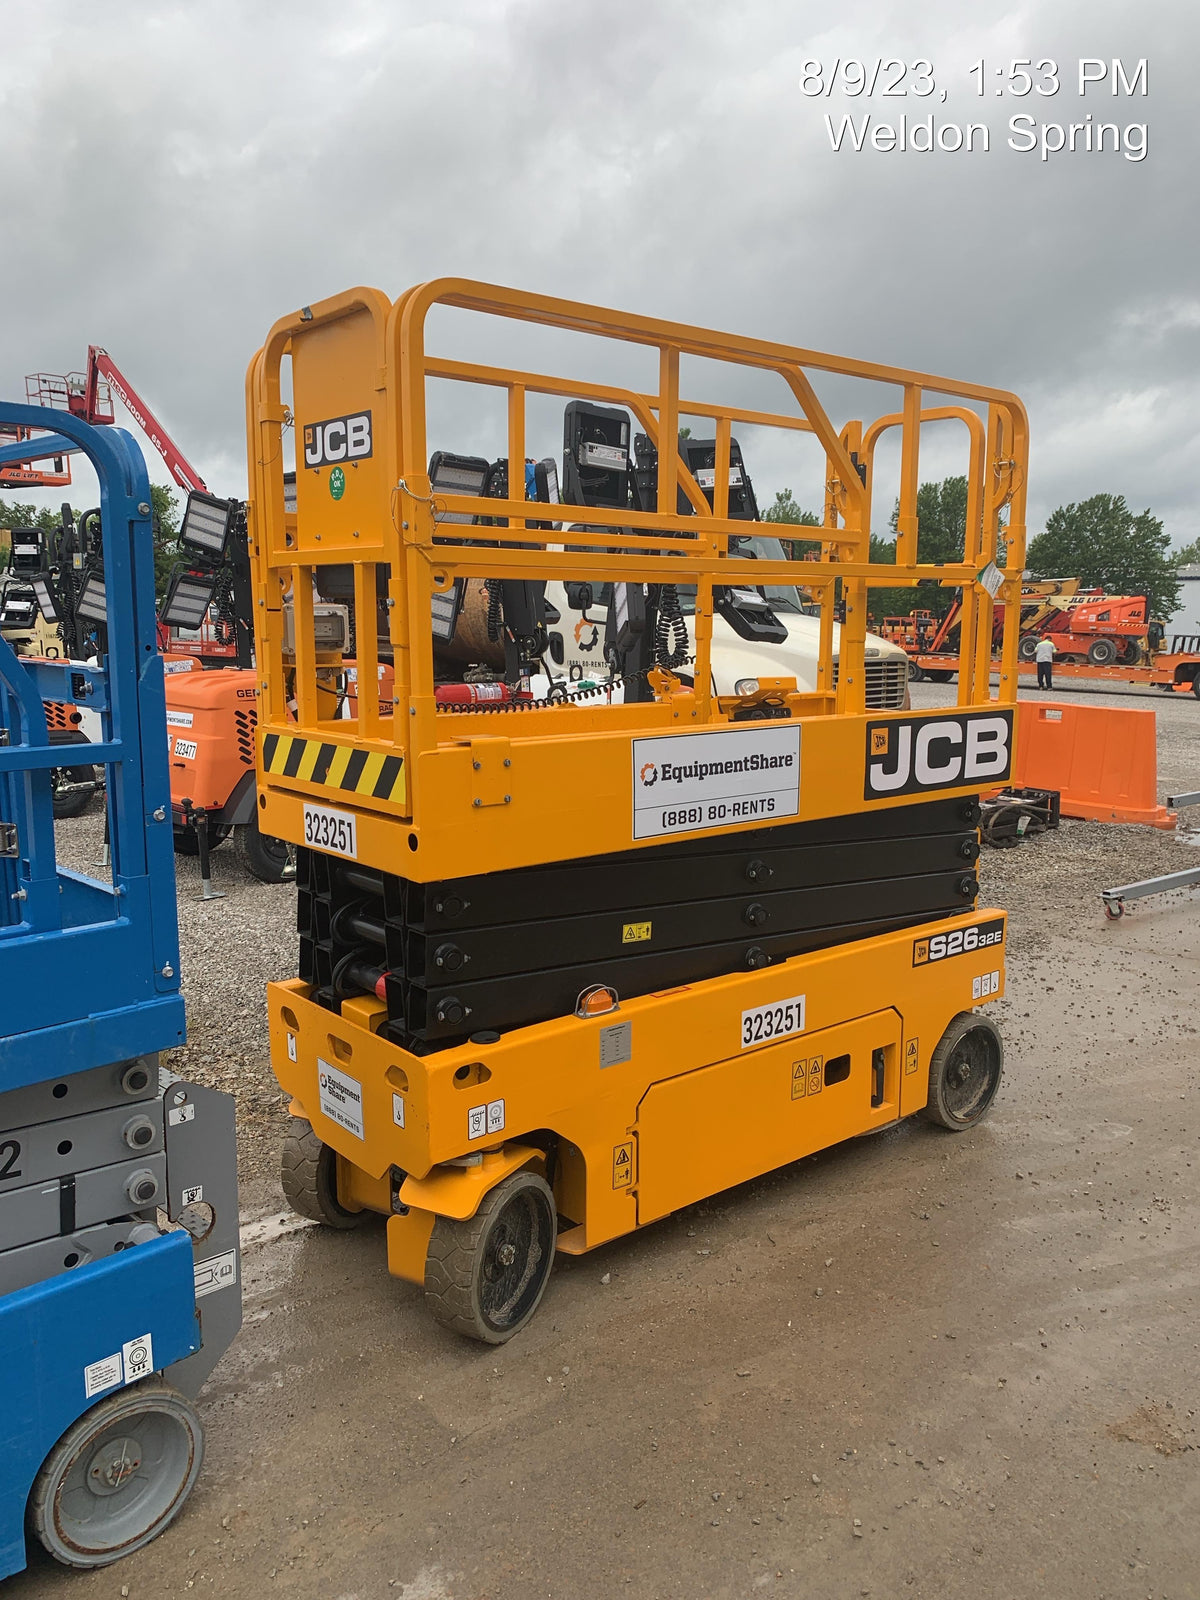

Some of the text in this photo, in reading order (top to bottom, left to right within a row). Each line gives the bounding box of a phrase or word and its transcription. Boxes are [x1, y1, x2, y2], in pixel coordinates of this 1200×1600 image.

[126, 399, 147, 429] BOOM
[151, 433, 168, 457] 65-J
[305, 415, 371, 465] JCB
[333, 480, 341, 488] OK
[175, 742, 197, 758] 323477
[870, 717, 1009, 792] JCB
[661, 753, 793, 783] EquipmentShare
[662, 798, 775, 828] (888) 80-RENTS
[305, 811, 353, 854] 323251
[743, 1002, 801, 1044] 323251
[327, 1074, 361, 1104] Equipment
[327, 1085, 347, 1104] Share
